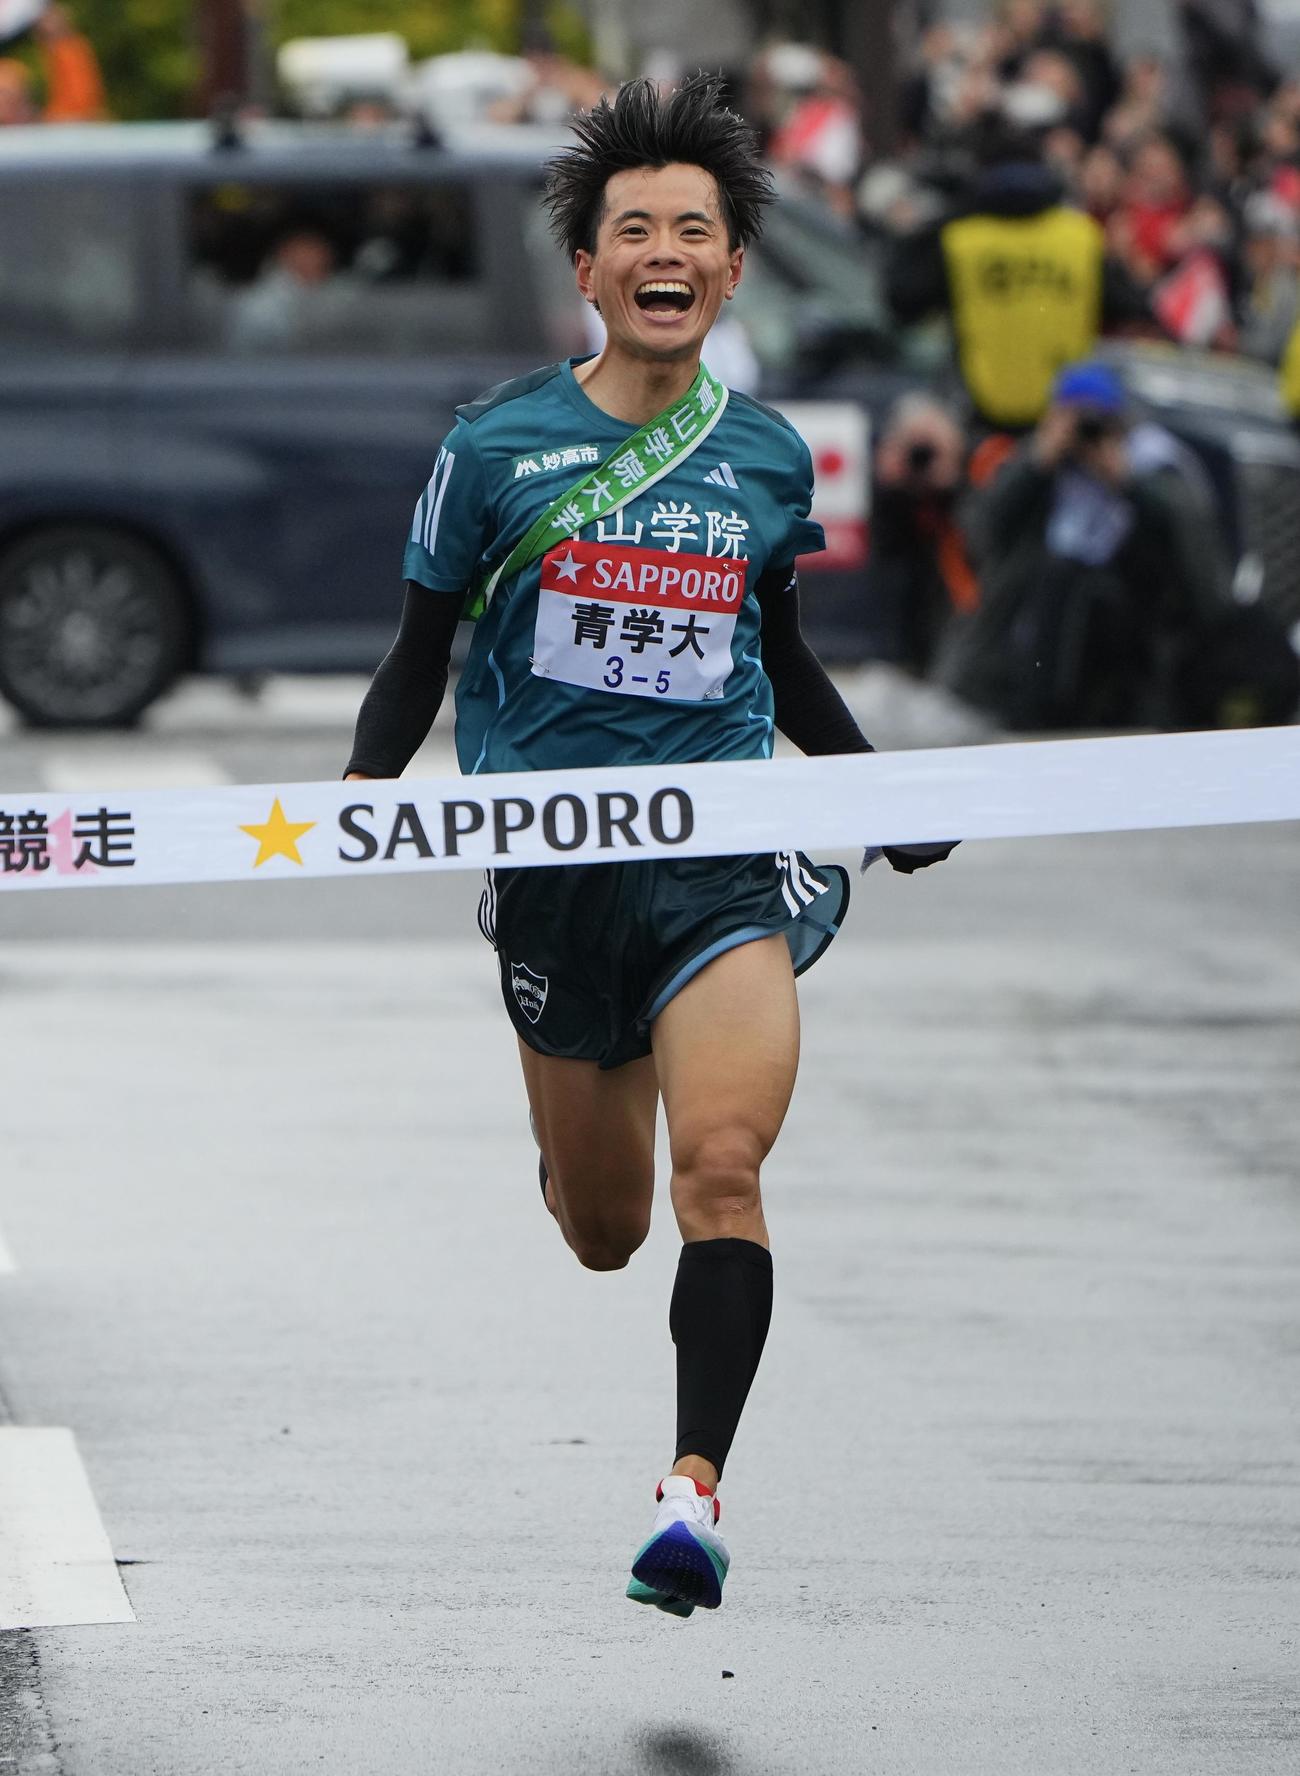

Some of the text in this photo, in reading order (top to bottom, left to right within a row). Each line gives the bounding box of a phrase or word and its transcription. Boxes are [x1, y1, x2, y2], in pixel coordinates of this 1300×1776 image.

[541, 446, 598, 471] 妙高市
[551, 376, 718, 534] 青山学院大学
[566, 500, 750, 561] 山学院
[592, 559, 739, 603] SAPPORO
[571, 603, 710, 660] 青学大
[603, 656, 671, 694] 3-5
[0, 807, 135, 873] 競走
[338, 787, 694, 862] SAPPORO
